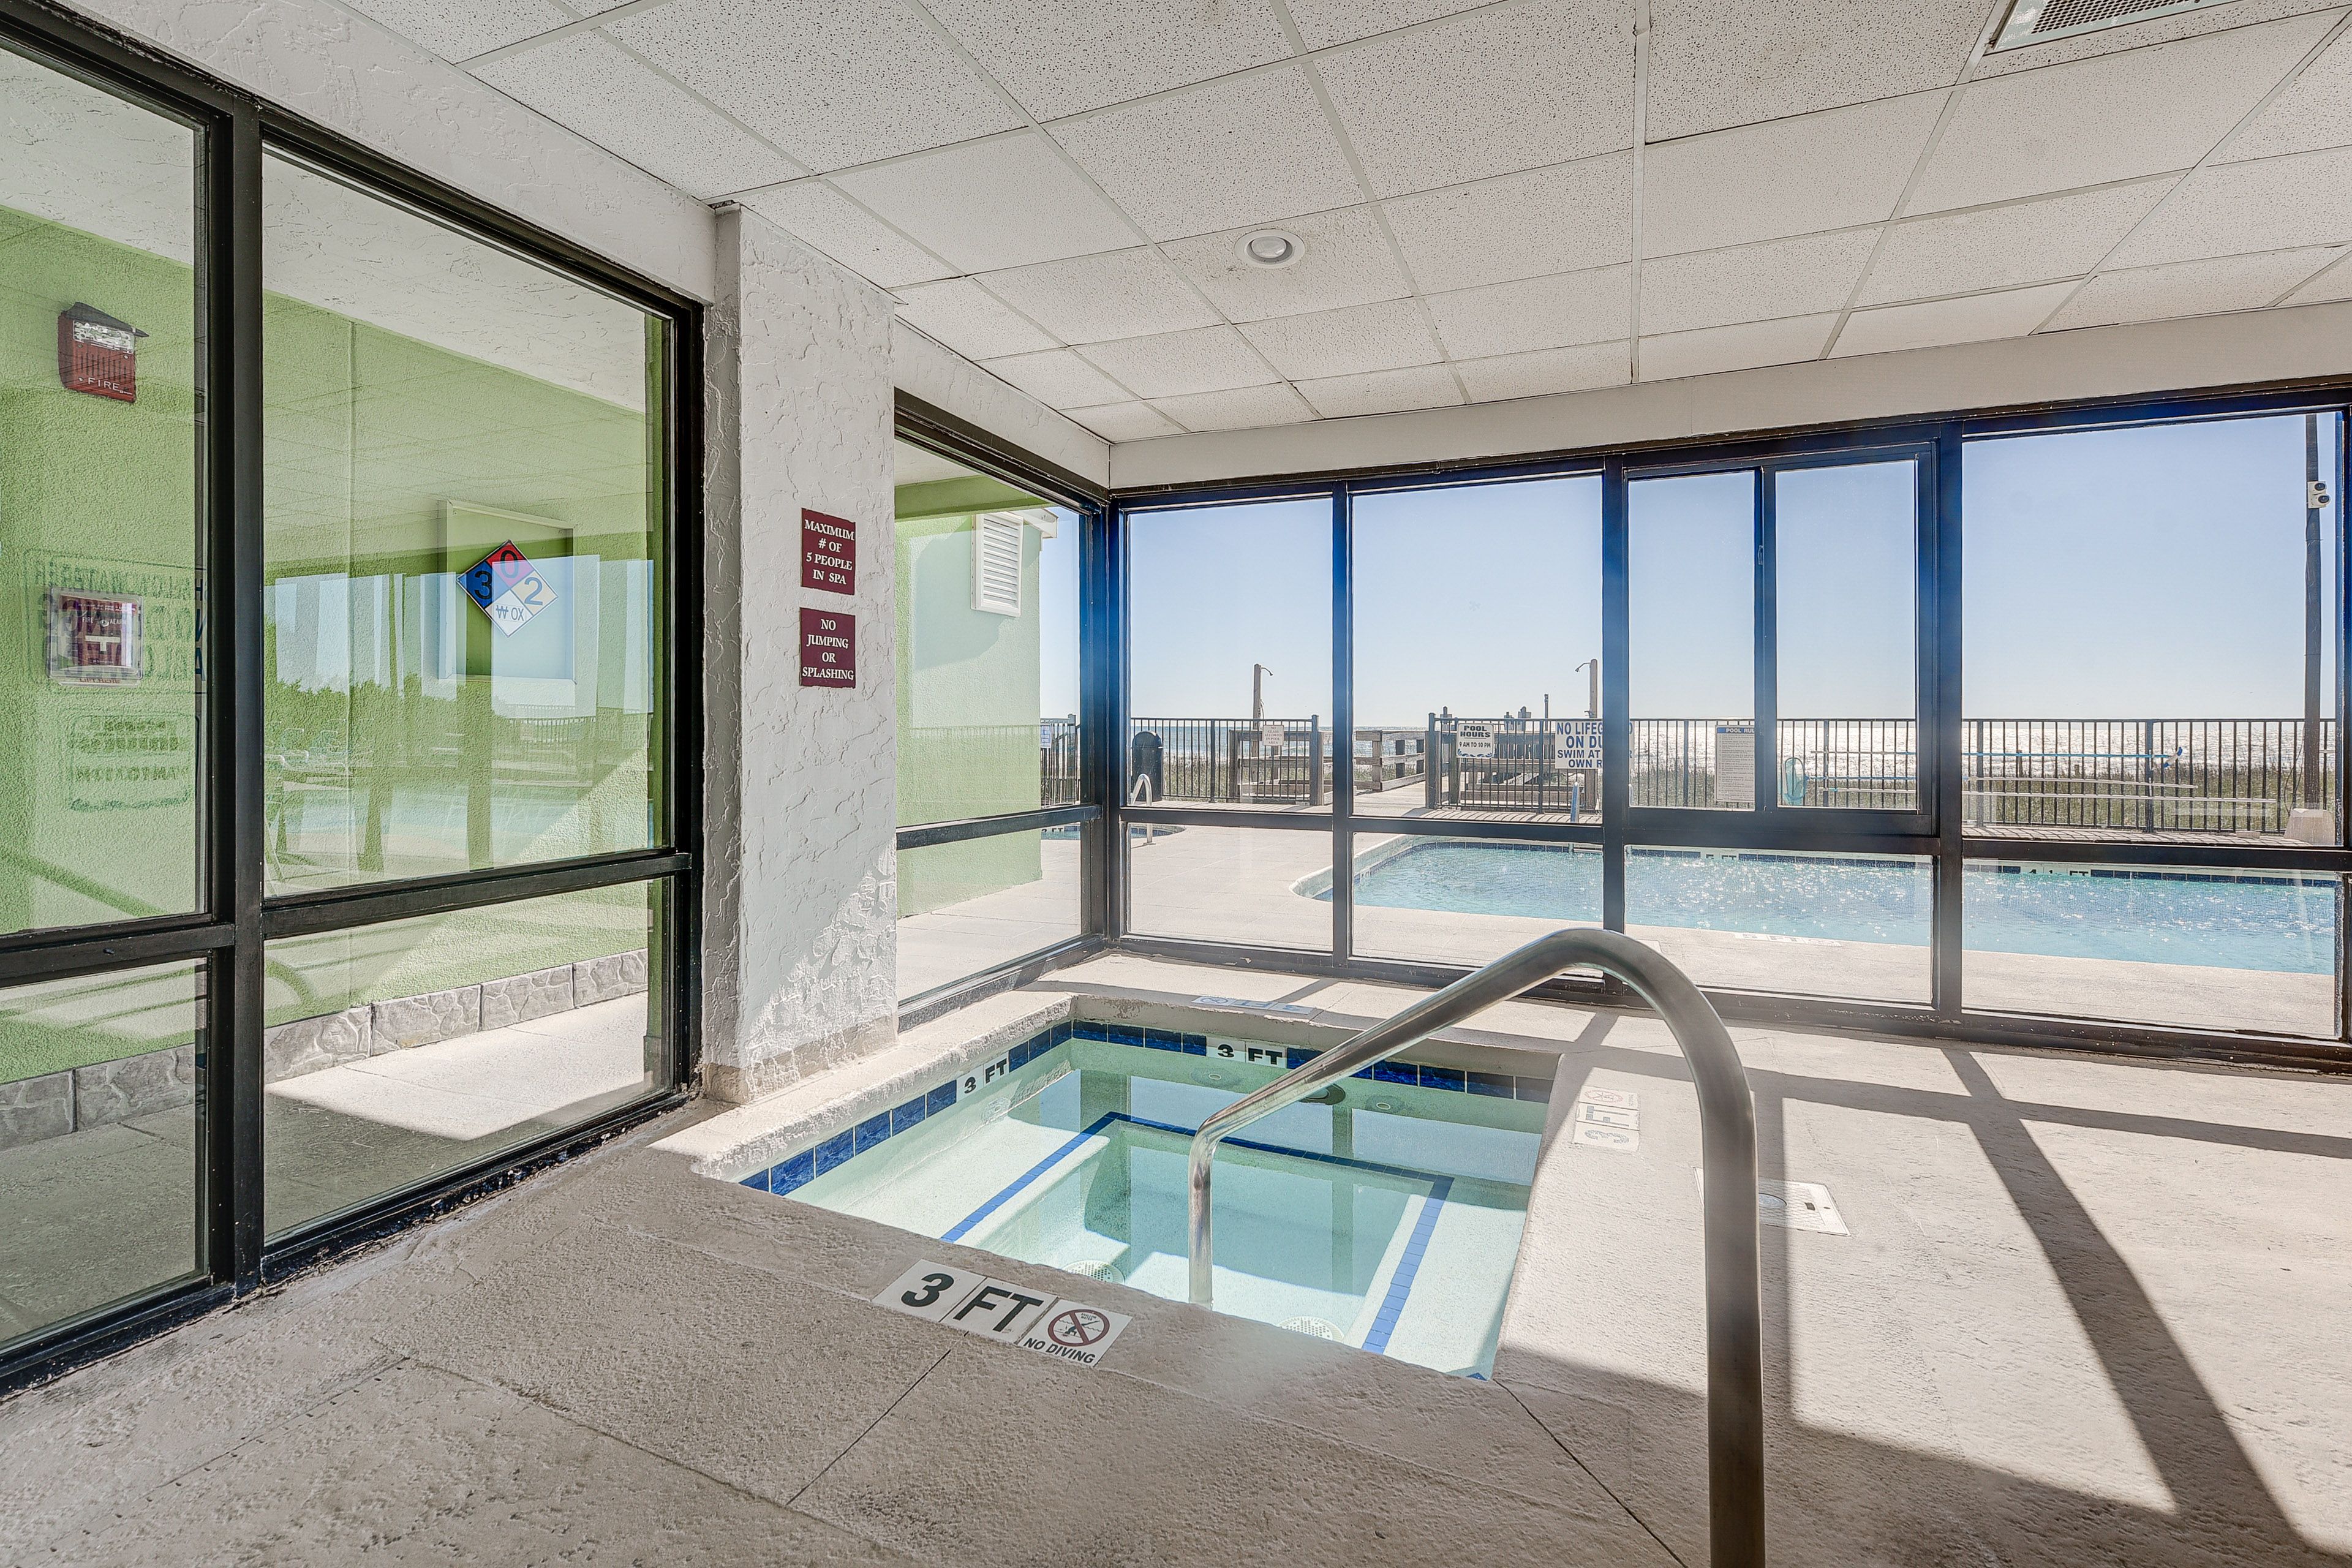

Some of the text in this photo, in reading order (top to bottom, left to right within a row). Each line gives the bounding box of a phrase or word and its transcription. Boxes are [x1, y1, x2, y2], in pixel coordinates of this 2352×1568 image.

[88, 377, 119, 391] FIRE
[804, 519, 855, 541] MAXIMUM
[818, 538, 842, 552] # OF
[806, 552, 853, 570] 5 PEOPLE
[813, 569, 846, 585] IN SPA
[474, 570, 492, 600] 3
[524, 577, 543, 605] 2
[511, 607, 524, 621] OX
[821, 619, 836, 630] NO
[806, 634, 849, 649] JUMPING
[822, 652, 837, 663] OR
[802, 666, 854, 680] SPLASHING
[1556, 722, 1572, 735] NO
[1566, 736, 1584, 748] ON
[1558, 750, 1600, 758] SWIM AT
[1218, 1044, 1283, 1065] 3 FT
[964, 1058, 1007, 1094] 3 FT
[901, 1273, 1044, 1333] 3 FT
[1024, 1337, 1096, 1363] NO DIVING
